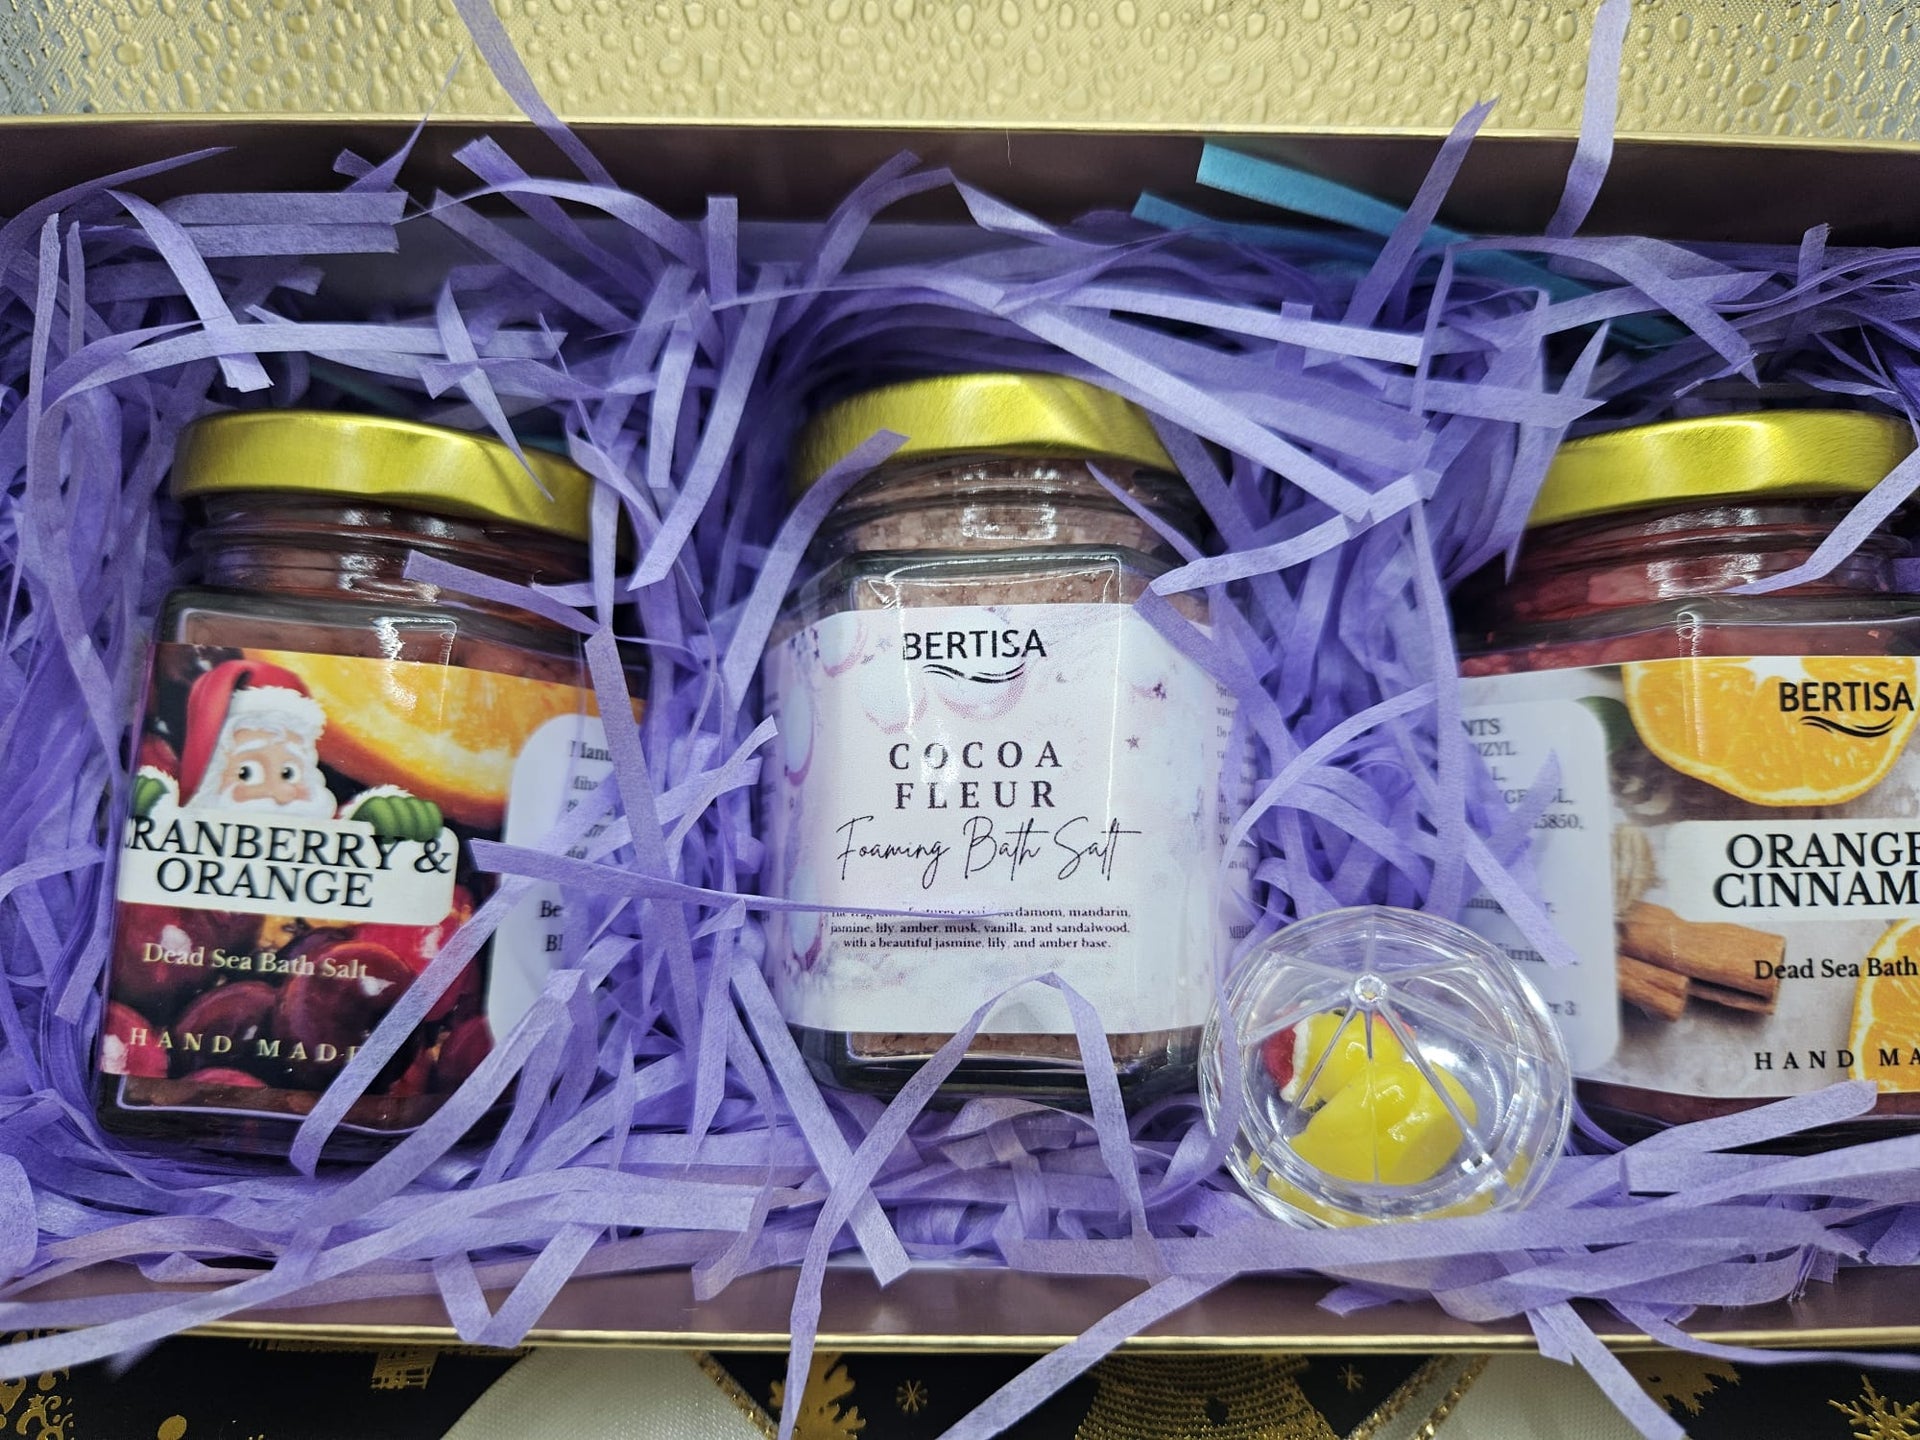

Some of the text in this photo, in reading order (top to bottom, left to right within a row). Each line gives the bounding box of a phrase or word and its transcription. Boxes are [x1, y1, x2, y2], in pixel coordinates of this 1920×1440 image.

[902, 629, 1048, 661] BERTISA
[1778, 681, 1916, 713] BERTISA
[889, 740, 1062, 770] COCOA
[895, 780, 1057, 810] FLEUR
[413, 836, 453, 874] &
[836, 815, 1142, 889] Foaming Bath Salt
[156, 857, 375, 908] ORANGE
[1069, 906, 1131, 918] mandarin,
[843, 937, 867, 948] with
[870, 940, 876, 948] a
[879, 937, 932, 948] beautiful
[1013, 937, 1035, 948] and
[1039, 937, 1078, 948] amber
[1081, 937, 1111, 948] base.
[944, 922, 981, 933] musk,
[984, 922, 1026, 933] vanilla,
[1030, 922, 1053, 933] and
[143, 942, 369, 980] Dead Sea Bath Salt
[1754, 955, 1919, 981] Dead Sea Bath
[130, 1027, 233, 1054] HAND
[1755, 1049, 1855, 1071] HAND
